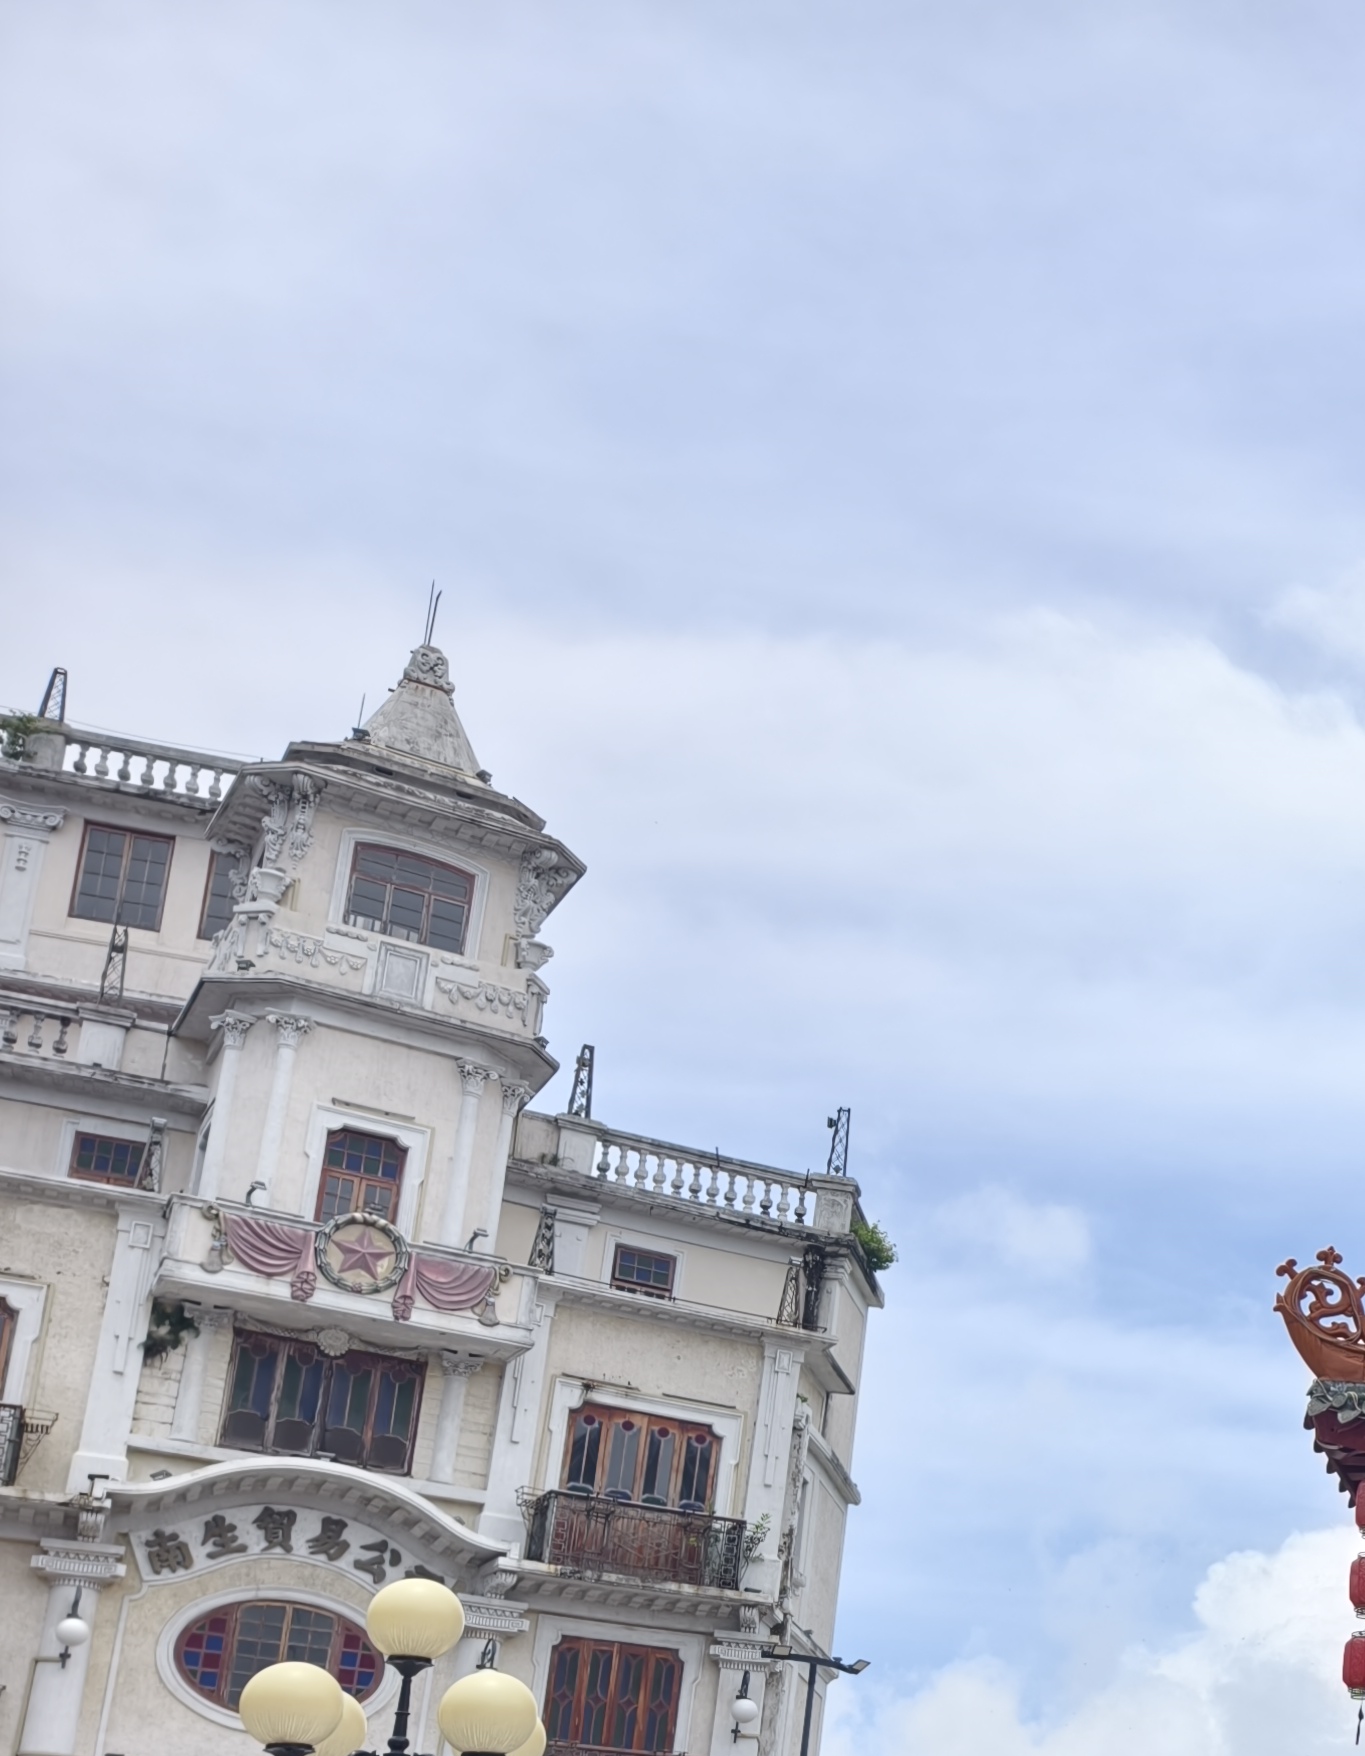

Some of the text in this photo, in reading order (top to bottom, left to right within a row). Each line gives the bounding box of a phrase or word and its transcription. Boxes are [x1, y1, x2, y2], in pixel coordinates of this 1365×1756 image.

[145, 1505, 446, 1586] 南生貿易公
